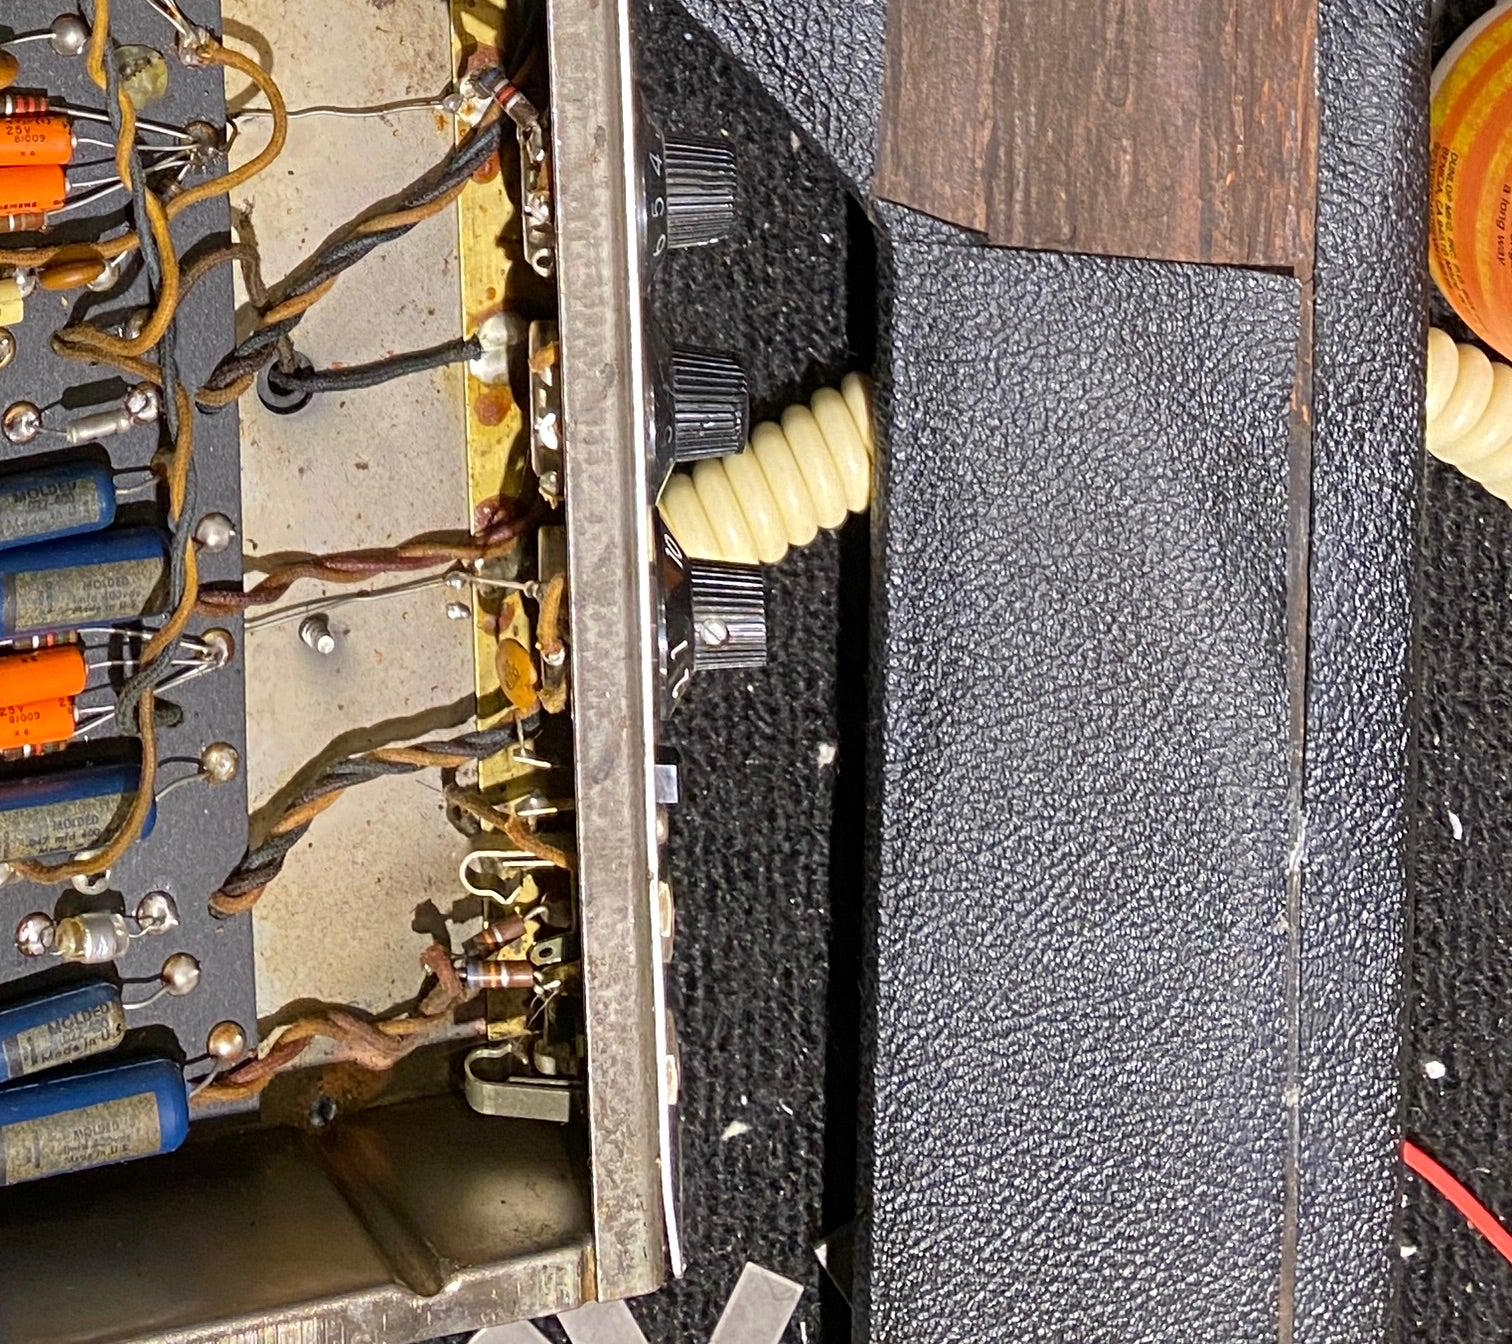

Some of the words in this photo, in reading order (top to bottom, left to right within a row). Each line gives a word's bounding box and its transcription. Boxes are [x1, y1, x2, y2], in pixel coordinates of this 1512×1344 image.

[6, 125, 31, 135] 25V
[648, 150, 663, 178] 4
[1445, 151, 1459, 203] DUNLOP
[650, 195, 666, 219] 5
[1494, 197, 1510, 229] long
[1496, 233, 1508, 267] way
[52, 813, 100, 832] MOLDED
[46, 1002, 110, 1036] MOLDED
[40, 1042, 82, 1063] Made
